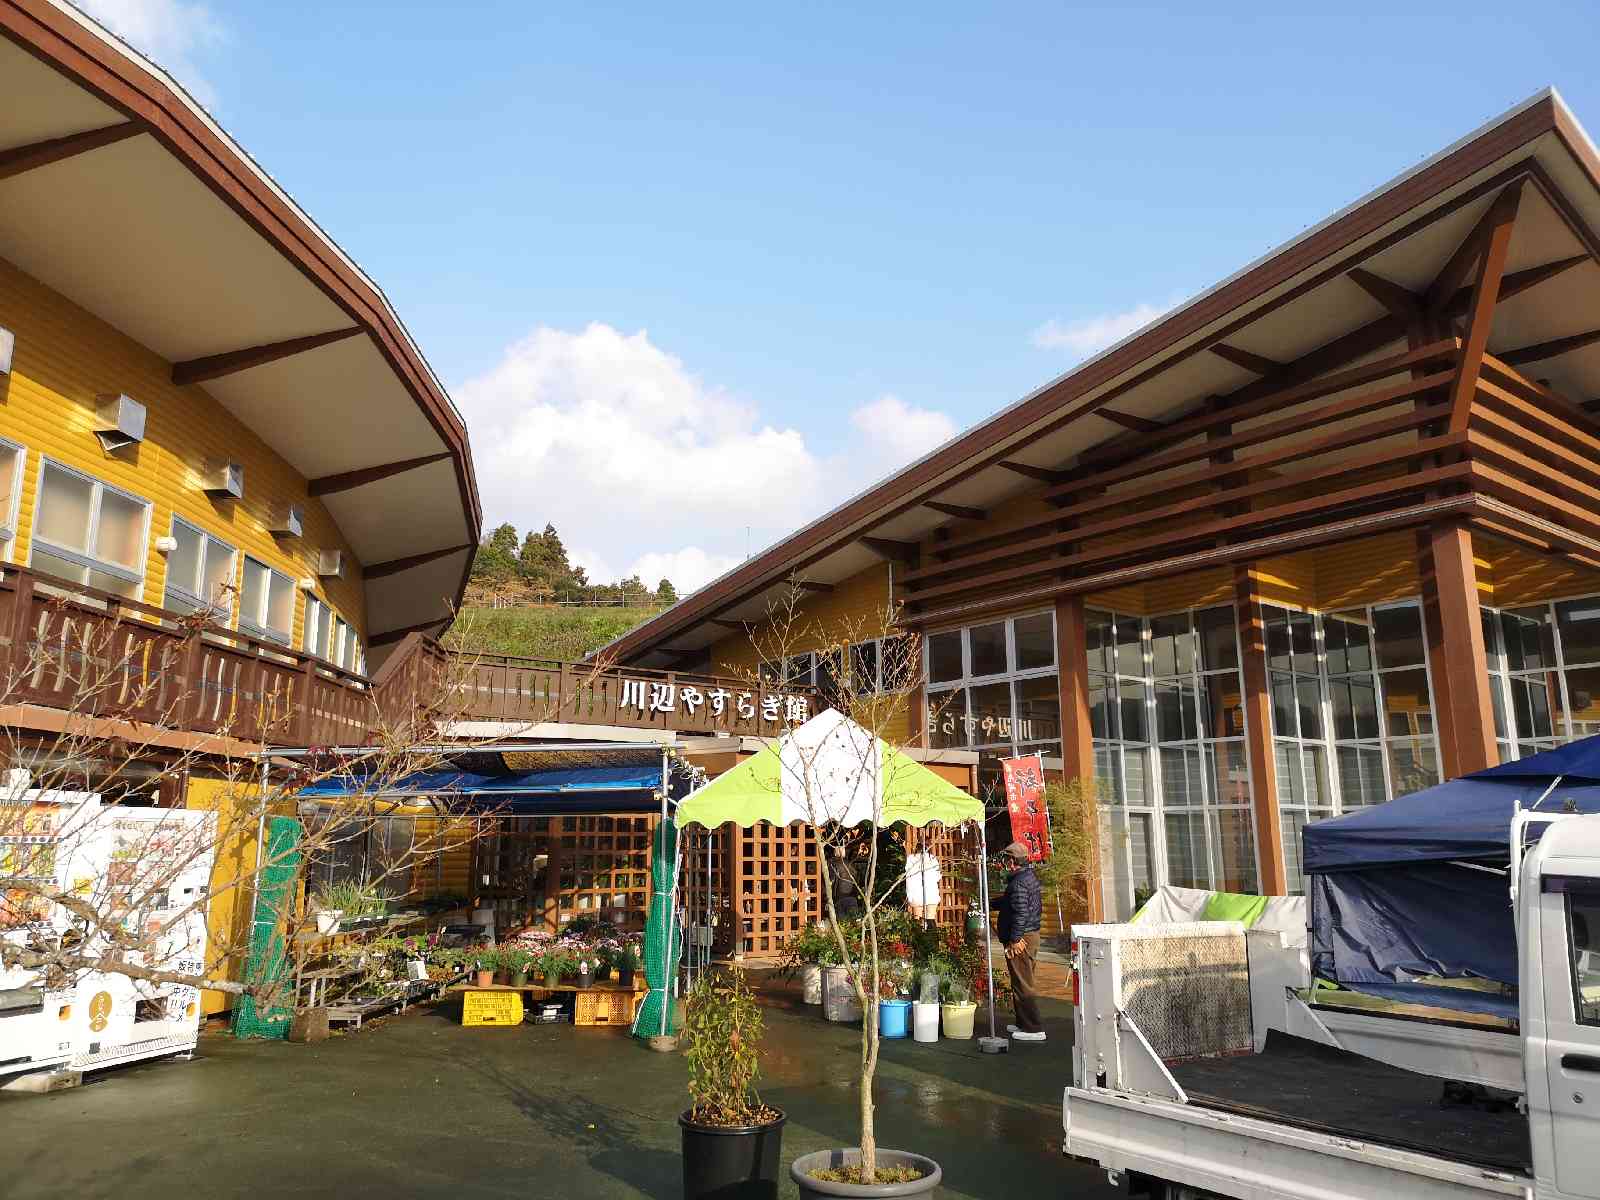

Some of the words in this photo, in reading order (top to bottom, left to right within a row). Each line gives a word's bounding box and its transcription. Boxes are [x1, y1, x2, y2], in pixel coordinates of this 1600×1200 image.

[620, 679, 808, 722] 川辺やすらぎ館
